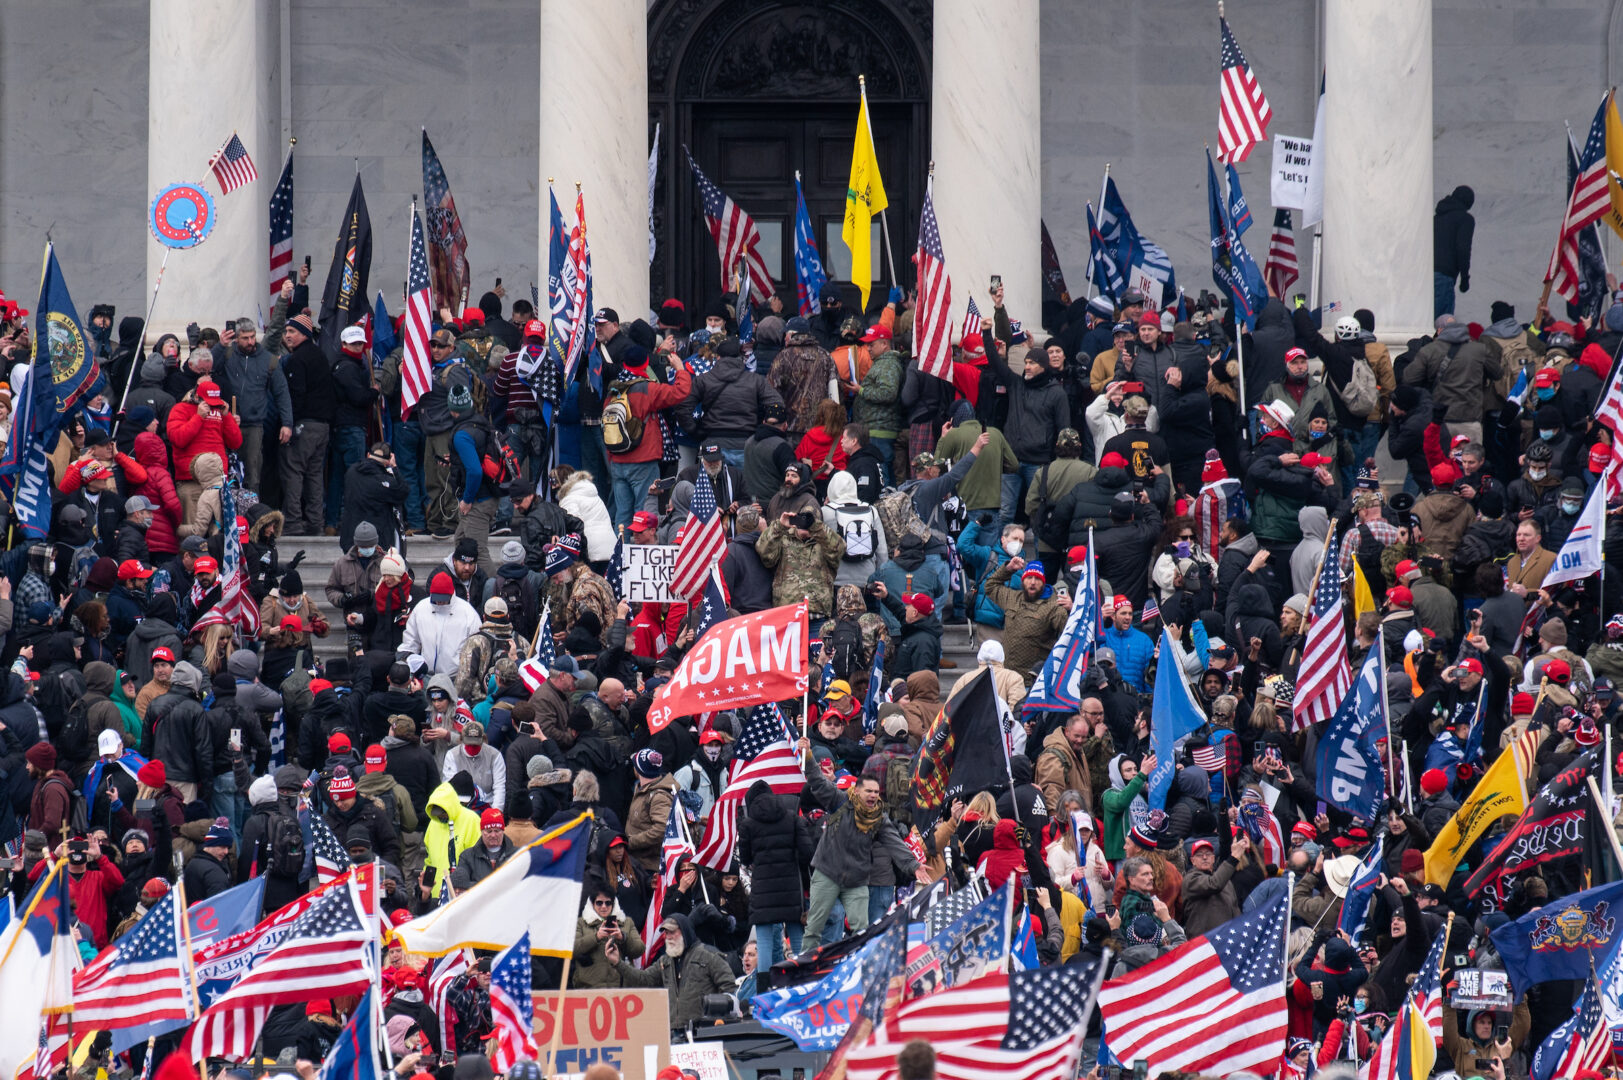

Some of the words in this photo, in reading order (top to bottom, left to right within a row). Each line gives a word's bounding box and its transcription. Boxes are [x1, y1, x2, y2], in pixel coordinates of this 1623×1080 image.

[1280, 139, 1298, 152] "We
[1299, 141, 1312, 153] ha
[1285, 153, 1293, 164] if
[1293, 156, 1306, 166] we
[1279, 170, 1303, 183] "Let's
[1139, 275, 1152, 294] THE
[330, 779, 353, 790] RUMP
[1459, 971, 1479, 981] WE
[1460, 980, 1479, 989] ARE
[1457, 988, 1479, 997] ONE
[531, 994, 644, 1047] STOP
[546, 1046, 623, 1074] THE
[671, 1051, 699, 1064] IGHT
[702, 1050, 719, 1061] FOR
